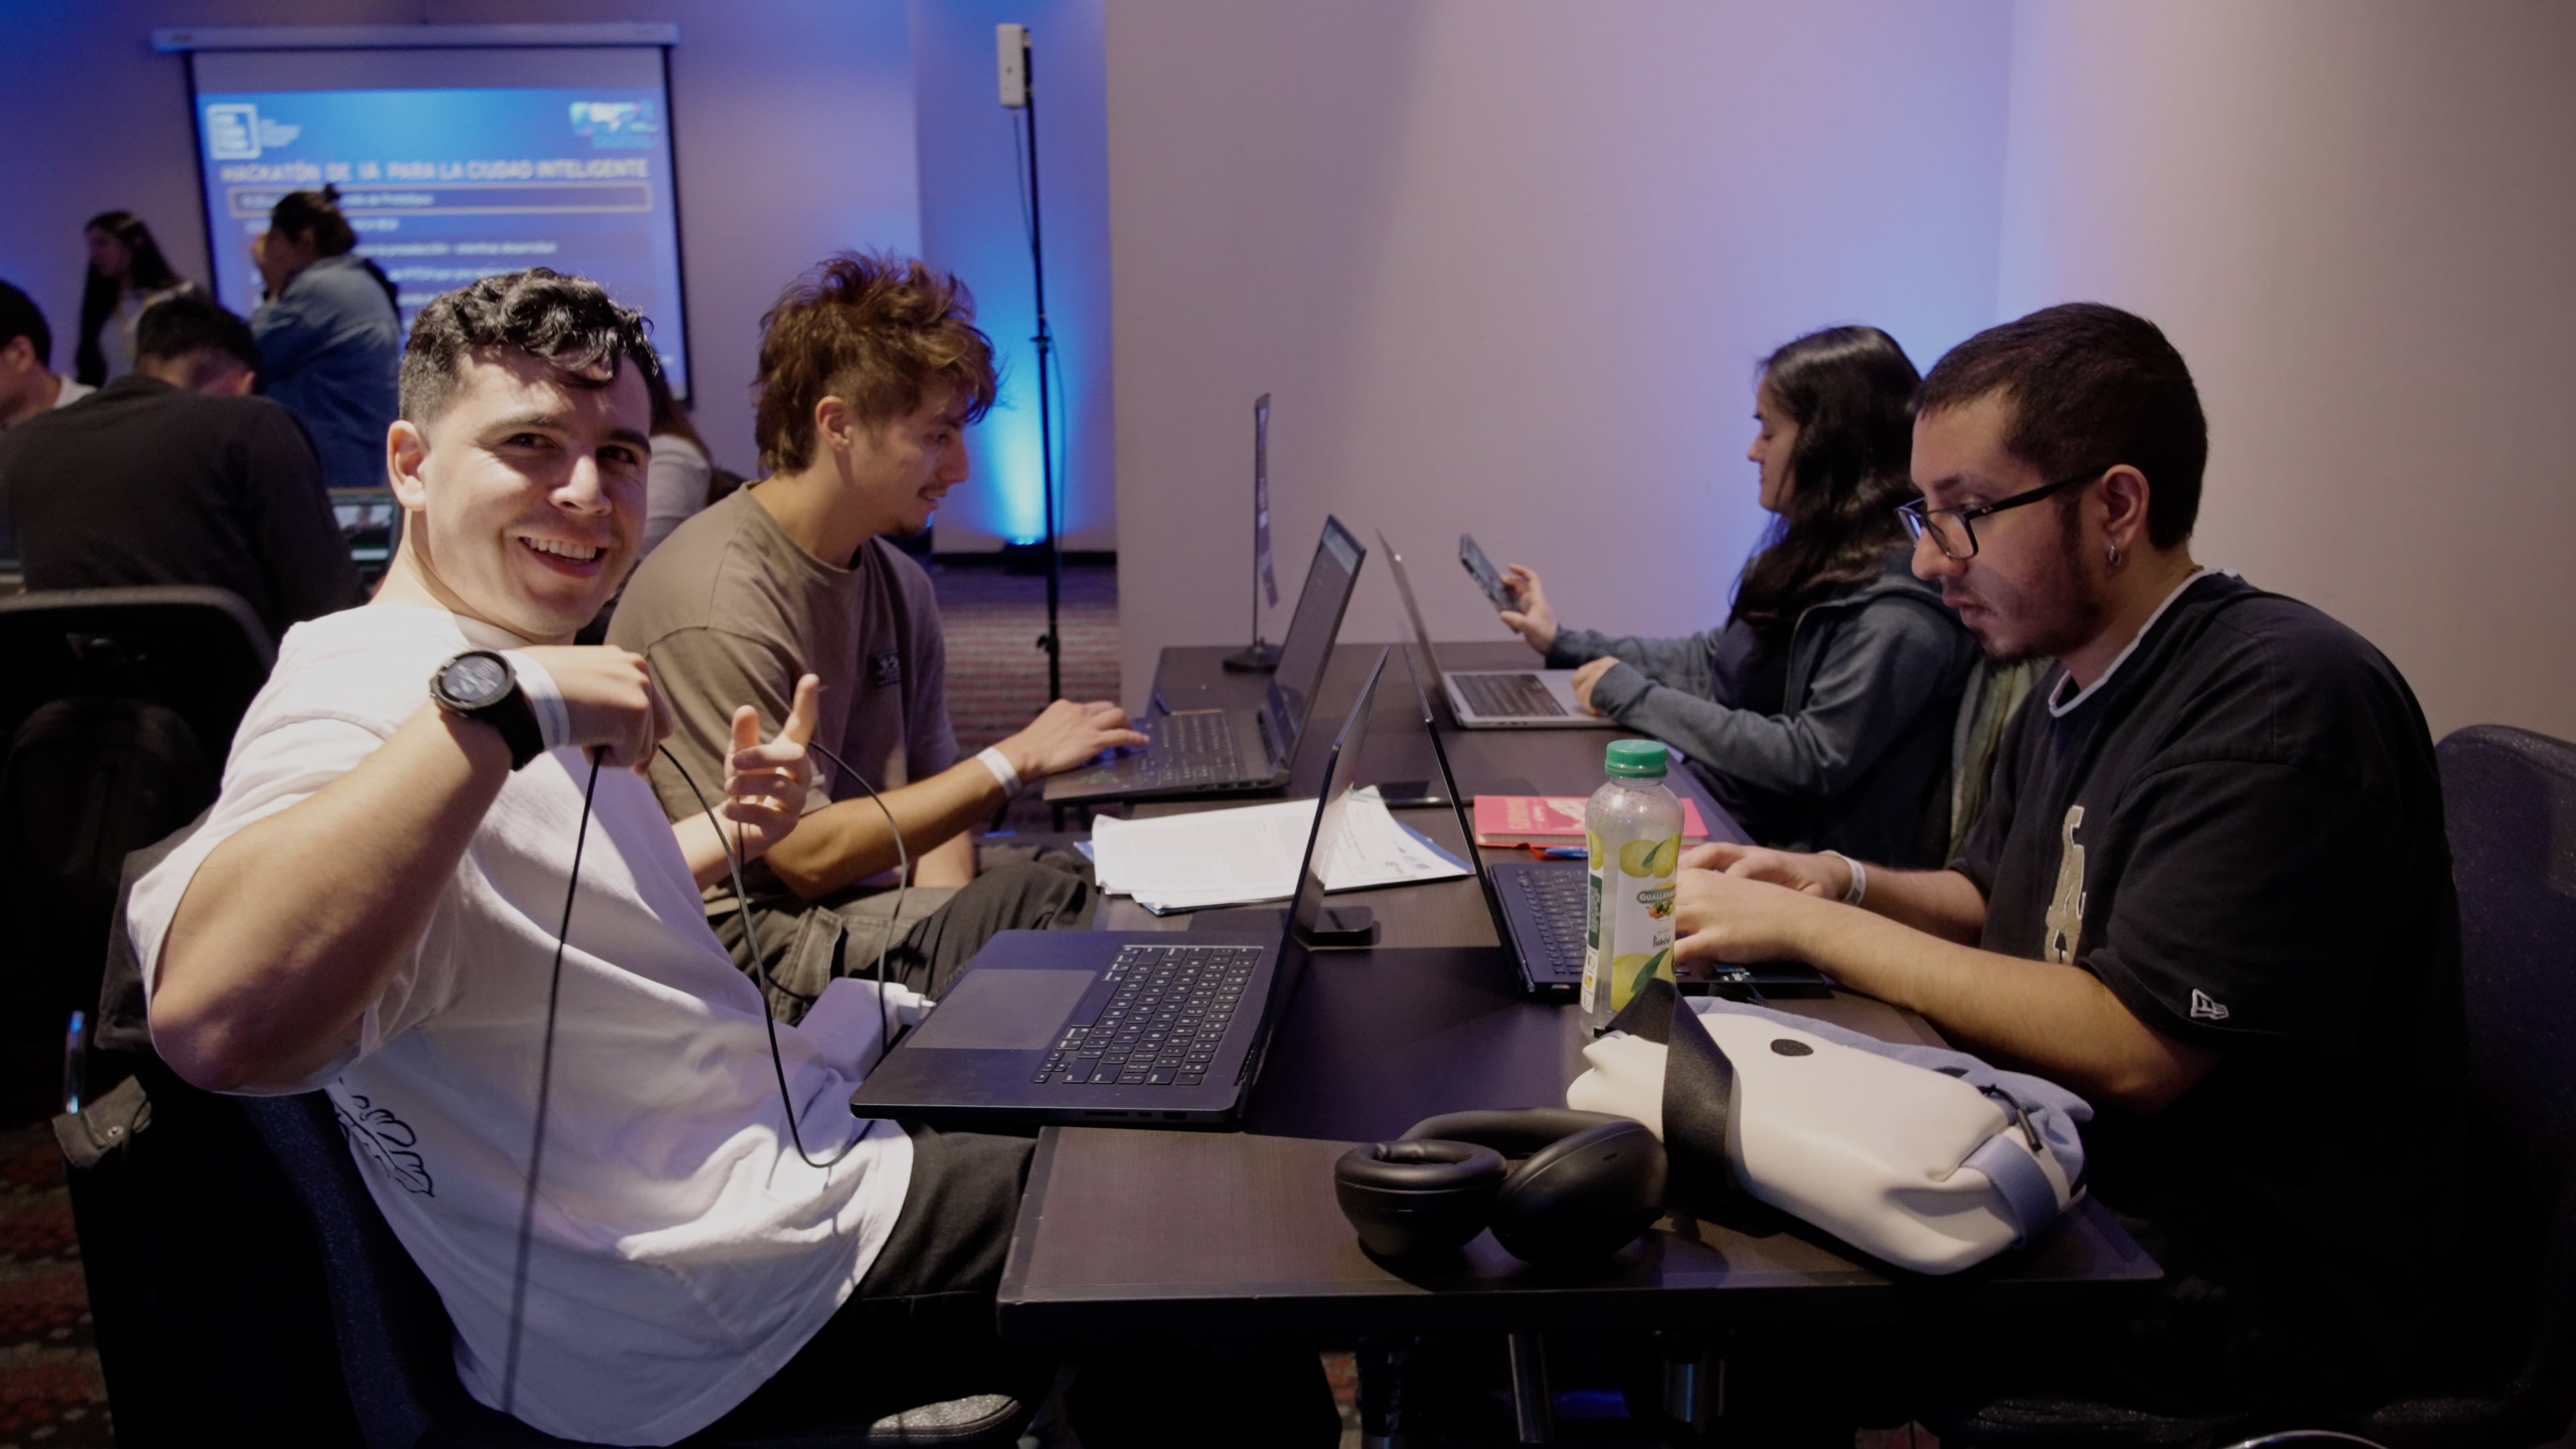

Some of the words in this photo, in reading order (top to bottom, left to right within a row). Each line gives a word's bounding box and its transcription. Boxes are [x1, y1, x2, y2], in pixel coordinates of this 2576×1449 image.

[326, 162, 351, 181] DE
[387, 161, 435, 180] PARA
[439, 161, 463, 180] LA
[466, 160, 533, 179] CIUDAD
[537, 158, 649, 178] INTELIGENTE
